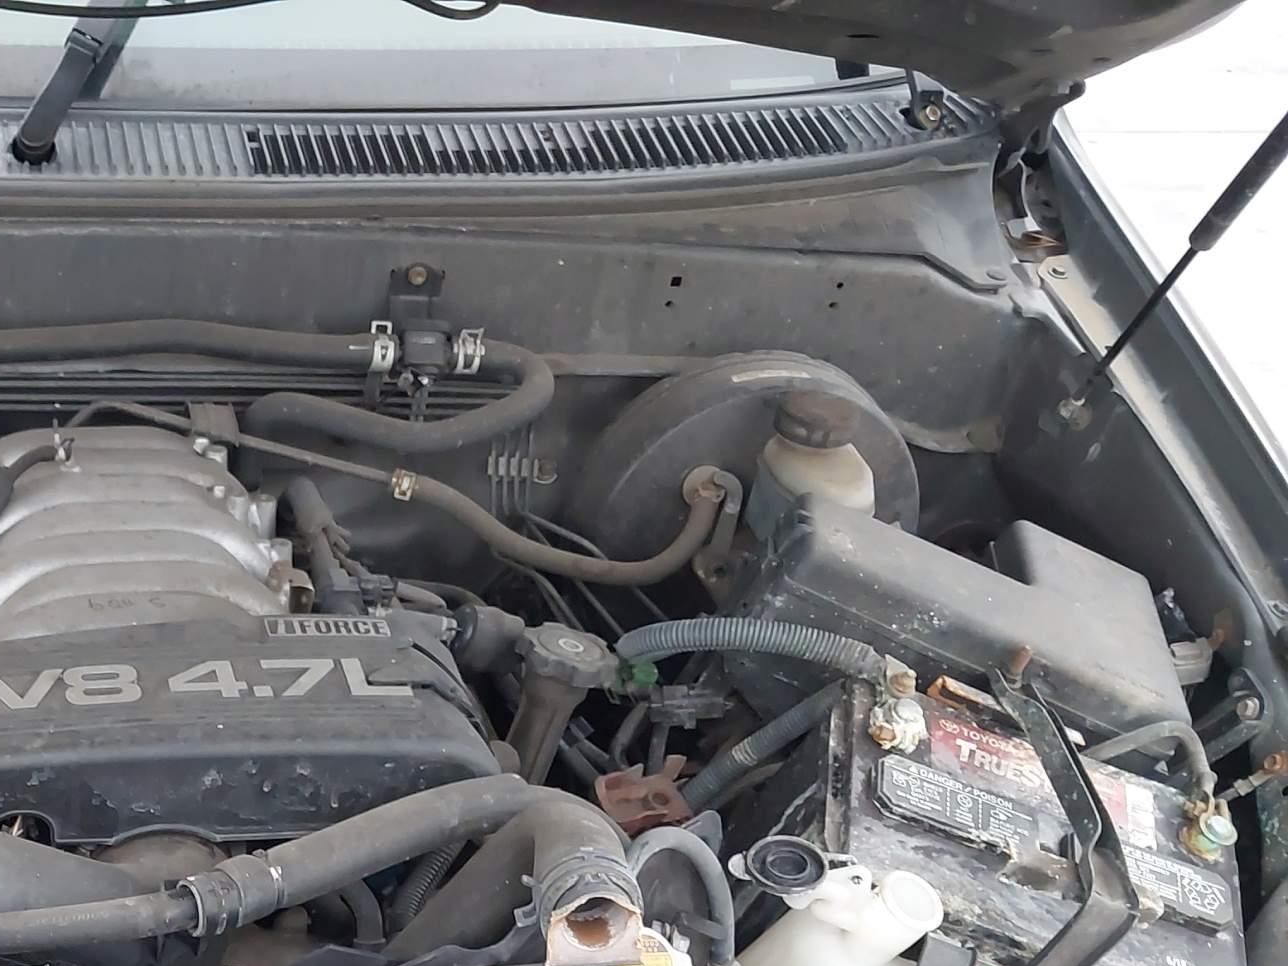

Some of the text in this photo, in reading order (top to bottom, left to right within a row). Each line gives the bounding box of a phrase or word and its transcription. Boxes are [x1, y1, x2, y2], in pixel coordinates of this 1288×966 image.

[167, 658, 414, 698] 4.7L
[961, 727, 1018, 754] TOYO
[955, 738, 1050, 793] TRUES
